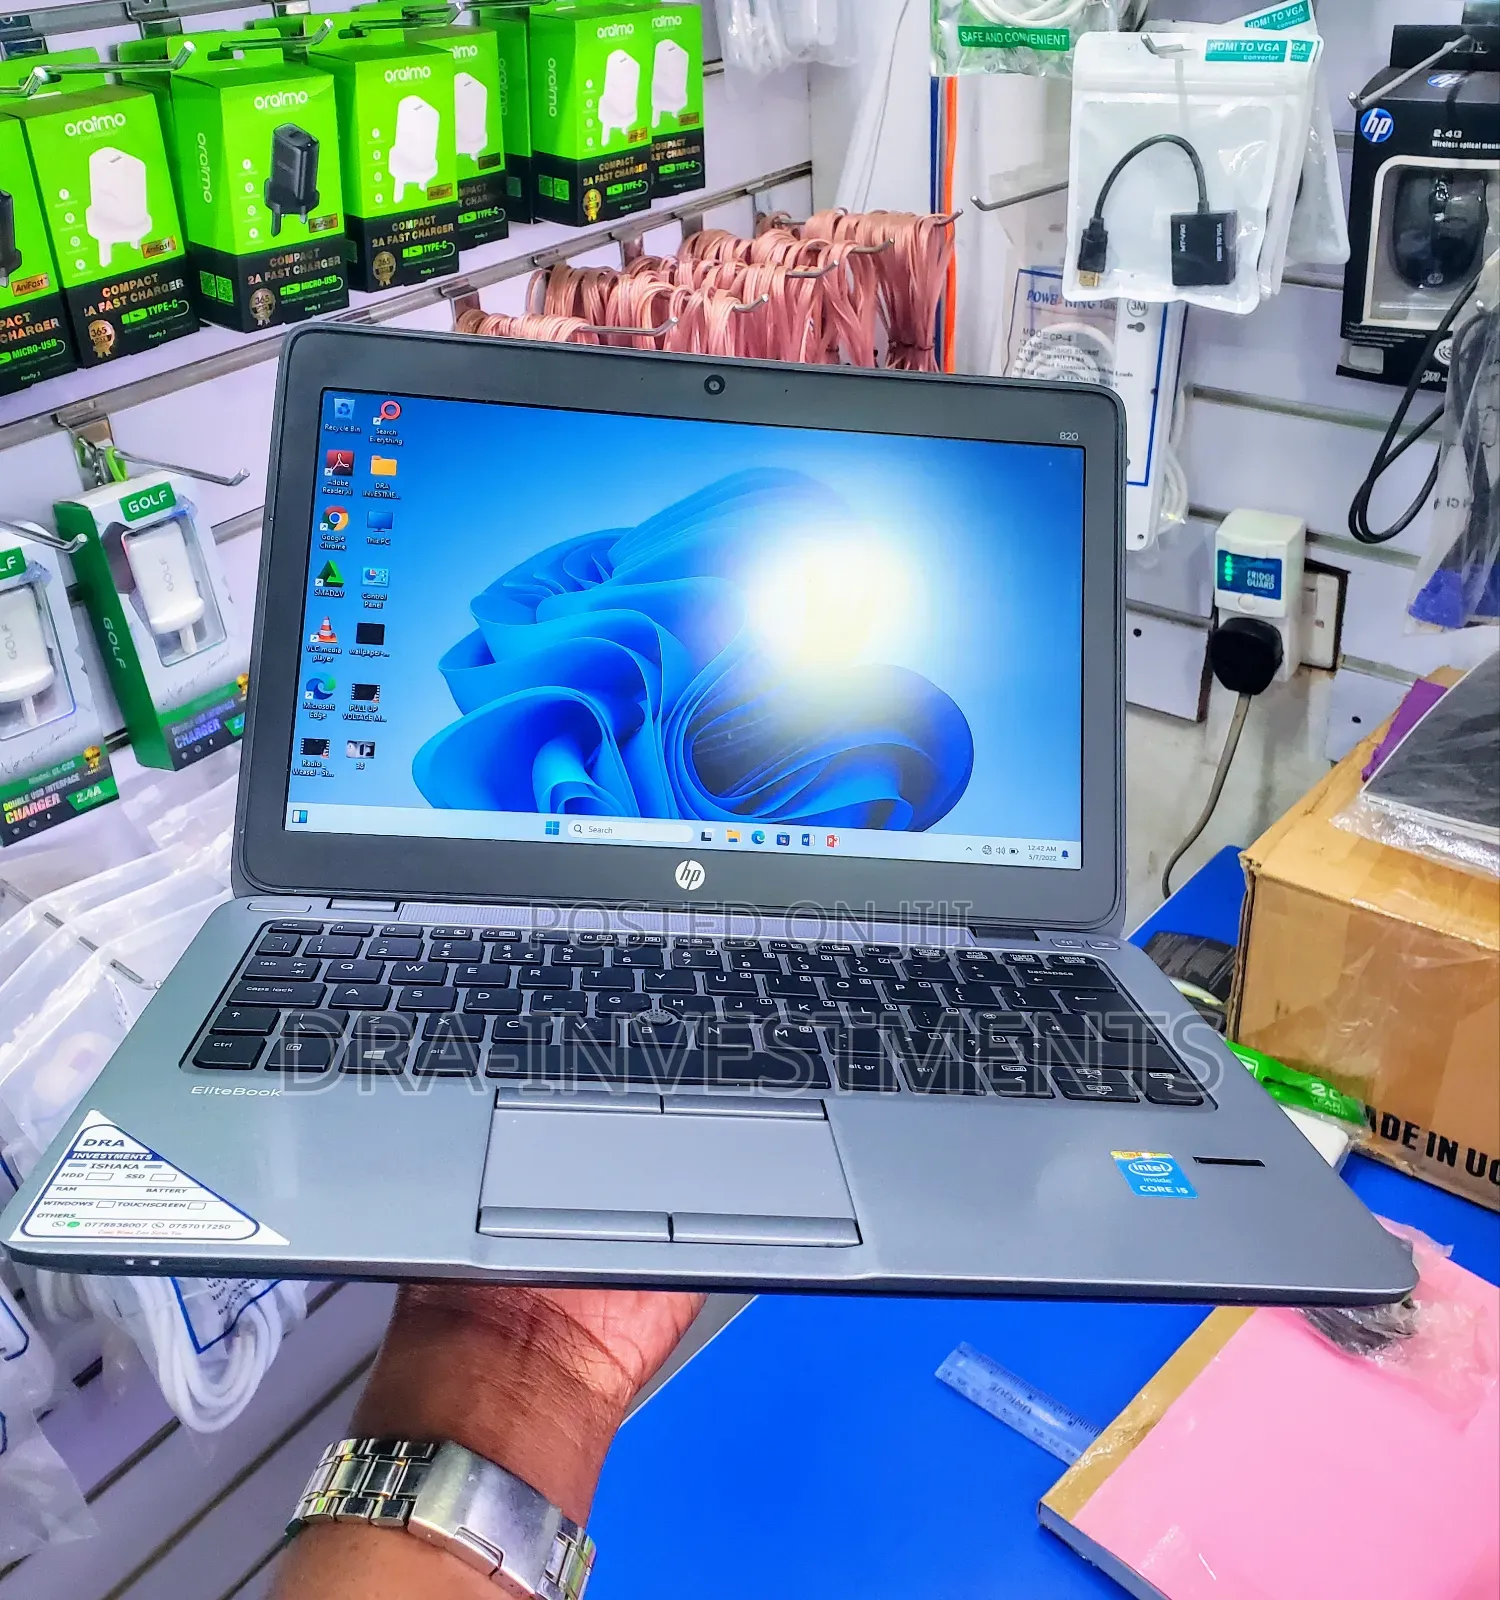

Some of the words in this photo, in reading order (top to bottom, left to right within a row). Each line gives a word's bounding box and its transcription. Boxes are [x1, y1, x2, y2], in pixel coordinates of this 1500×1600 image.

[1272, 11, 1284, 22] TO
[1285, 4, 1304, 18] VGA
[597, 23, 634, 39] oraimo
[961, 31, 985, 43] SAFE
[985, 32, 1003, 43] AND
[1004, 32, 1067, 46] CONVENIENT
[1208, 42, 1238, 52] HDMI
[1240, 42, 1254, 52] TO
[1257, 42, 1280, 52] VGA
[384, 65, 431, 84] oraimo
[548, 57, 557, 117] oraimo
[254, 90, 309, 110] oraimo
[64, 113, 126, 137] oraimo
[1361, 108, 1394, 142] hp
[1432, 140, 1459, 149] Wireless
[1459, 141, 1481, 149] optical
[197, 132, 213, 203] oraimo
[599, 156, 635, 172] COMPACT
[595, 172, 614, 184] FAST
[614, 163, 648, 179] CHARGER
[477, 206, 499, 219] TYPE-C
[392, 215, 437, 232] COMPACT
[372, 237, 385, 248] 2A
[386, 232, 411, 242] FAST
[412, 223, 454, 240] CHARGER
[423, 240, 448, 254] TYPE-C
[269, 248, 320, 268] COMPACT
[248, 273, 262, 285] 2A
[264, 267, 291, 281] FAST
[293, 255, 341, 275] CHARGER
[15, 277, 45, 292] AniFast
[102, 273, 159, 298] COMPACT
[301, 274, 337, 291] MICRO-USB
[98, 296, 127, 314] FAST
[130, 278, 185, 304] CHARGER
[147, 299, 179, 316] TYPE-C
[1130, 301, 1147, 312] 3M
[90, 327, 108, 337] 365
[12, 339, 58, 359] MICRO-USB
[324, 423, 349, 433] Recycle
[376, 427, 397, 436] Search
[1059, 431, 1079, 442] 820
[128, 489, 168, 514] GOLF
[321, 534, 345, 543] Google
[367, 536, 379, 544] This
[320, 542, 346, 550] Chrome
[1247, 570, 1275, 583] FRIDGE
[1247, 578, 1275, 590] GUARD
[362, 592, 387, 600] Control
[103, 617, 127, 670] GOLF
[321, 646, 342, 654] media
[312, 654, 334, 663] player
[303, 701, 335, 711] Microsoft
[349, 704, 367, 712] PULL
[309, 711, 327, 720] Edge
[342, 713, 373, 721] VOLTAGE
[174, 718, 221, 749] CHARGER
[3, 795, 30, 812] DOUBLE
[44, 773, 80, 793] INTERFACE
[76, 785, 102, 804] 2.4A
[5, 793, 61, 824] CHARGER
[588, 824, 613, 835] Search
[1028, 844, 1045, 852] 12:42
[678, 860, 703, 890] hp
[405, 964, 423, 972] W
[1027, 969, 1074, 977] backspace
[345, 988, 359, 996] A
[798, 1003, 811, 1011] K
[368, 1016, 382, 1024] Z
[641, 1026, 652, 1034] B
[708, 1026, 720, 1034] N
[775, 1029, 788, 1037] M
[190, 1085, 282, 1098] EliteBook
[83, 1138, 125, 1148] DRA
[1425, 1131, 1459, 1167] IN
[72, 1152, 152, 1161] INVESTMENTS
[89, 1162, 140, 1170] ISHAKA
[1134, 1162, 1167, 1172] intel
[1143, 1176, 1172, 1184] inside
[1139, 1185, 1174, 1194] CORE
